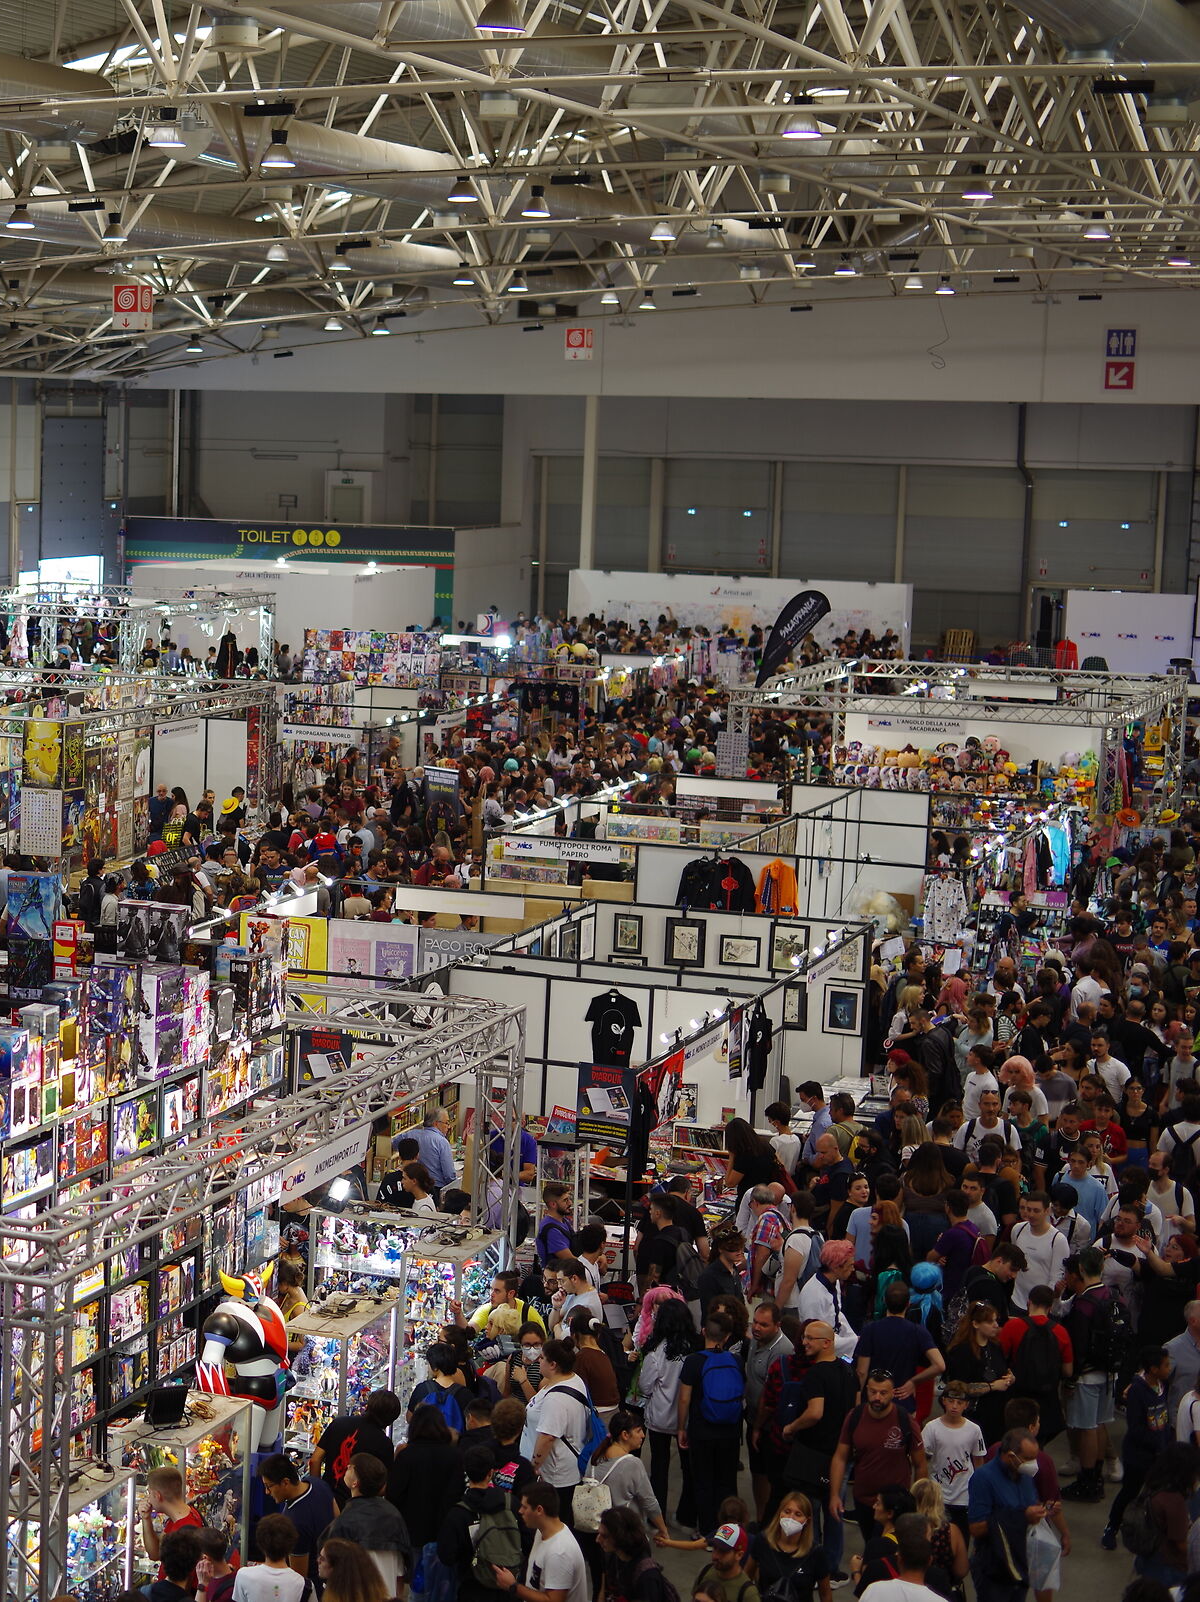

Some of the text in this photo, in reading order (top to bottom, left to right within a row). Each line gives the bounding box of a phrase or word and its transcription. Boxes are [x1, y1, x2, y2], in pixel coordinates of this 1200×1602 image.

[238, 530, 290, 544] TOILET
[295, 729, 331, 738] PROPAGANDA
[909, 725, 947, 733] SACADRANCA
[539, 840, 590, 850] FUMETTOPOLI
[590, 844, 612, 852] ROMA
[561, 850, 589, 859] PAPIRO
[424, 938, 461, 951] PACO
[591, 1071, 623, 1084] DIABOLIK
[314, 1141, 360, 1176] ANIMEIMPORT.IT
[380, 1180, 403, 1201] JOR
